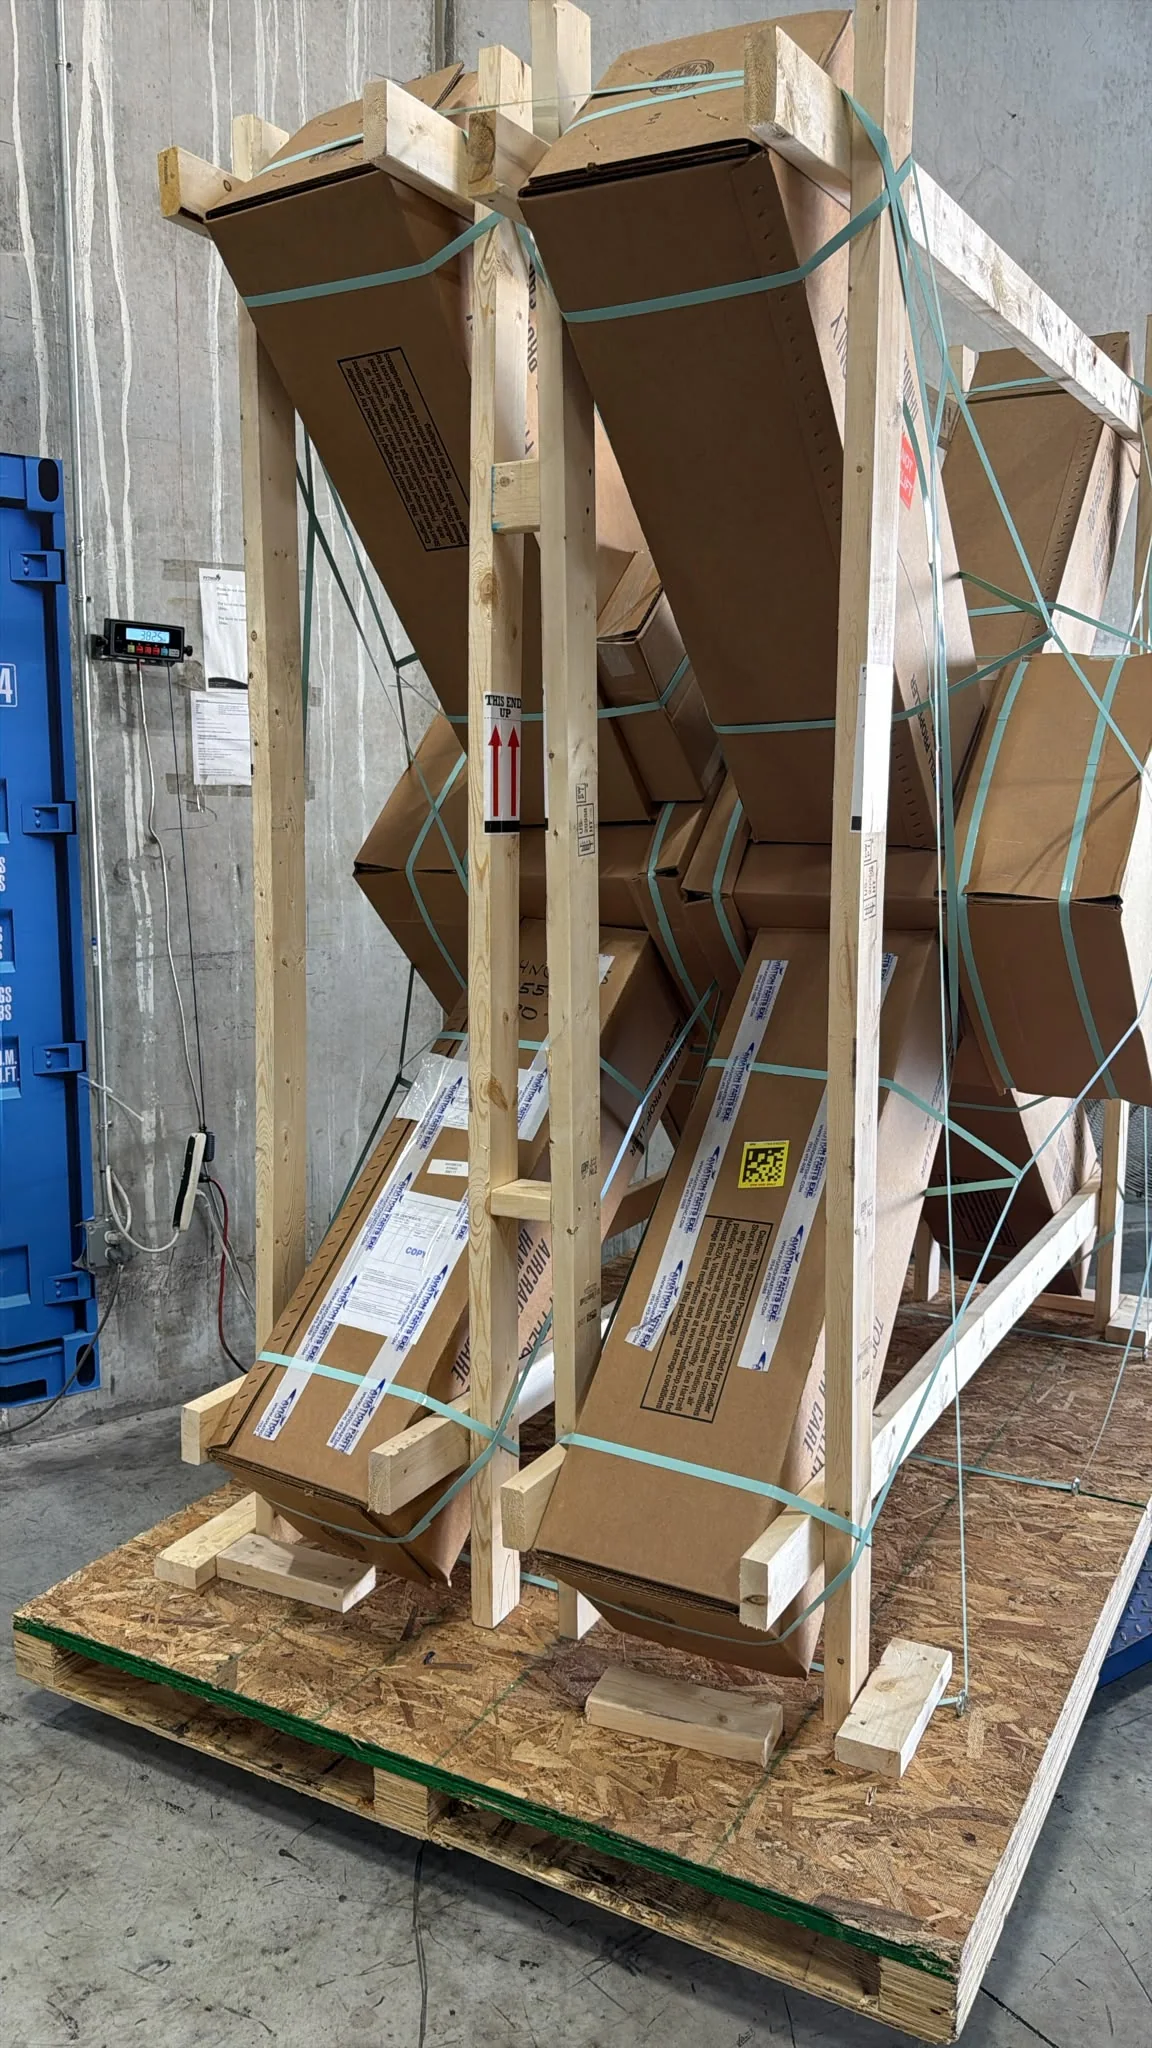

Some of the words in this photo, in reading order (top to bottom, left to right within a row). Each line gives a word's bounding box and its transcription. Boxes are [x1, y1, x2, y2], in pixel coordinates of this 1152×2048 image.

[485, 694, 505, 708] THIS
[506, 696, 522, 709] END
[500, 708, 511, 718] UP
[734, 1051, 750, 1082] AVIATION
[436, 1084, 458, 1114] AVIATION
[524, 1073, 545, 1102] AVIATION
[726, 1084, 739, 1106] PARTS
[425, 1114, 442, 1135] PARTS
[698, 1156, 716, 1190] AVIATION
[811, 1156, 823, 1180] PARTS
[384, 1180, 406, 1212] AVIATION
[805, 1181, 816, 1198] EXE.
[690, 1192, 704, 1216] PARTS
[372, 1212, 389, 1235] PARTS
[684, 1217, 695, 1233] EXE.
[710, 1219, 725, 1241] storage
[719, 1220, 734, 1241] Manual
[705, 1242, 717, 1255] time
[782, 1236, 798, 1274] AVIATION
[700, 1256, 712, 1270] limit
[726, 1248, 742, 1276] Preferred
[734, 1258, 748, 1281] storage
[746, 1258, 757, 1271] This
[417, 1274, 441, 1310] AVIATION
[657, 1272, 681, 1308] AVIATION
[680, 1291, 691, 1302] this
[685, 1281, 695, 1290] for
[688, 1270, 707, 1304] restrictions
[716, 1277, 732, 1309] conditions
[737, 1272, 753, 1300] Standard
[774, 1276, 787, 1302] PARTS
[328, 1285, 351, 1320] AVIATION
[683, 1305, 695, 1317] and
[693, 1291, 710, 1319] available
[724, 1299, 735, 1313] than
[768, 1304, 779, 1322] EXE.
[404, 1310, 422, 1334] PARTS
[711, 1310, 722, 1324] limit
[727, 1301, 744, 1334] Packaging
[315, 1320, 333, 1345] PARTS
[673, 1318, 691, 1347] preferred
[697, 1324, 708, 1336] and
[394, 1335, 408, 1352] EXE.
[698, 1324, 717, 1363] temperature
[664, 1348, 680, 1373] storage
[665, 1327, 698, 1400] www.hartzellprop.com
[703, 1349, 719, 1379] Preferred
[716, 1342, 731, 1371] intended
[681, 1370, 693, 1383] See
[712, 1371, 722, 1382] for
[652, 1374, 671, 1409] conditions
[672, 1384, 688, 1410] Hartzell
[684, 1395, 694, 1406] air
[691, 1380, 709, 1416] conditions
[702, 1382, 719, 1413] propeller
[265, 1399, 290, 1437] AVIATION
[351, 1389, 378, 1427] AVIATION
[662, 1401, 673, 1411] for
[803, 1400, 824, 1458] CARE
